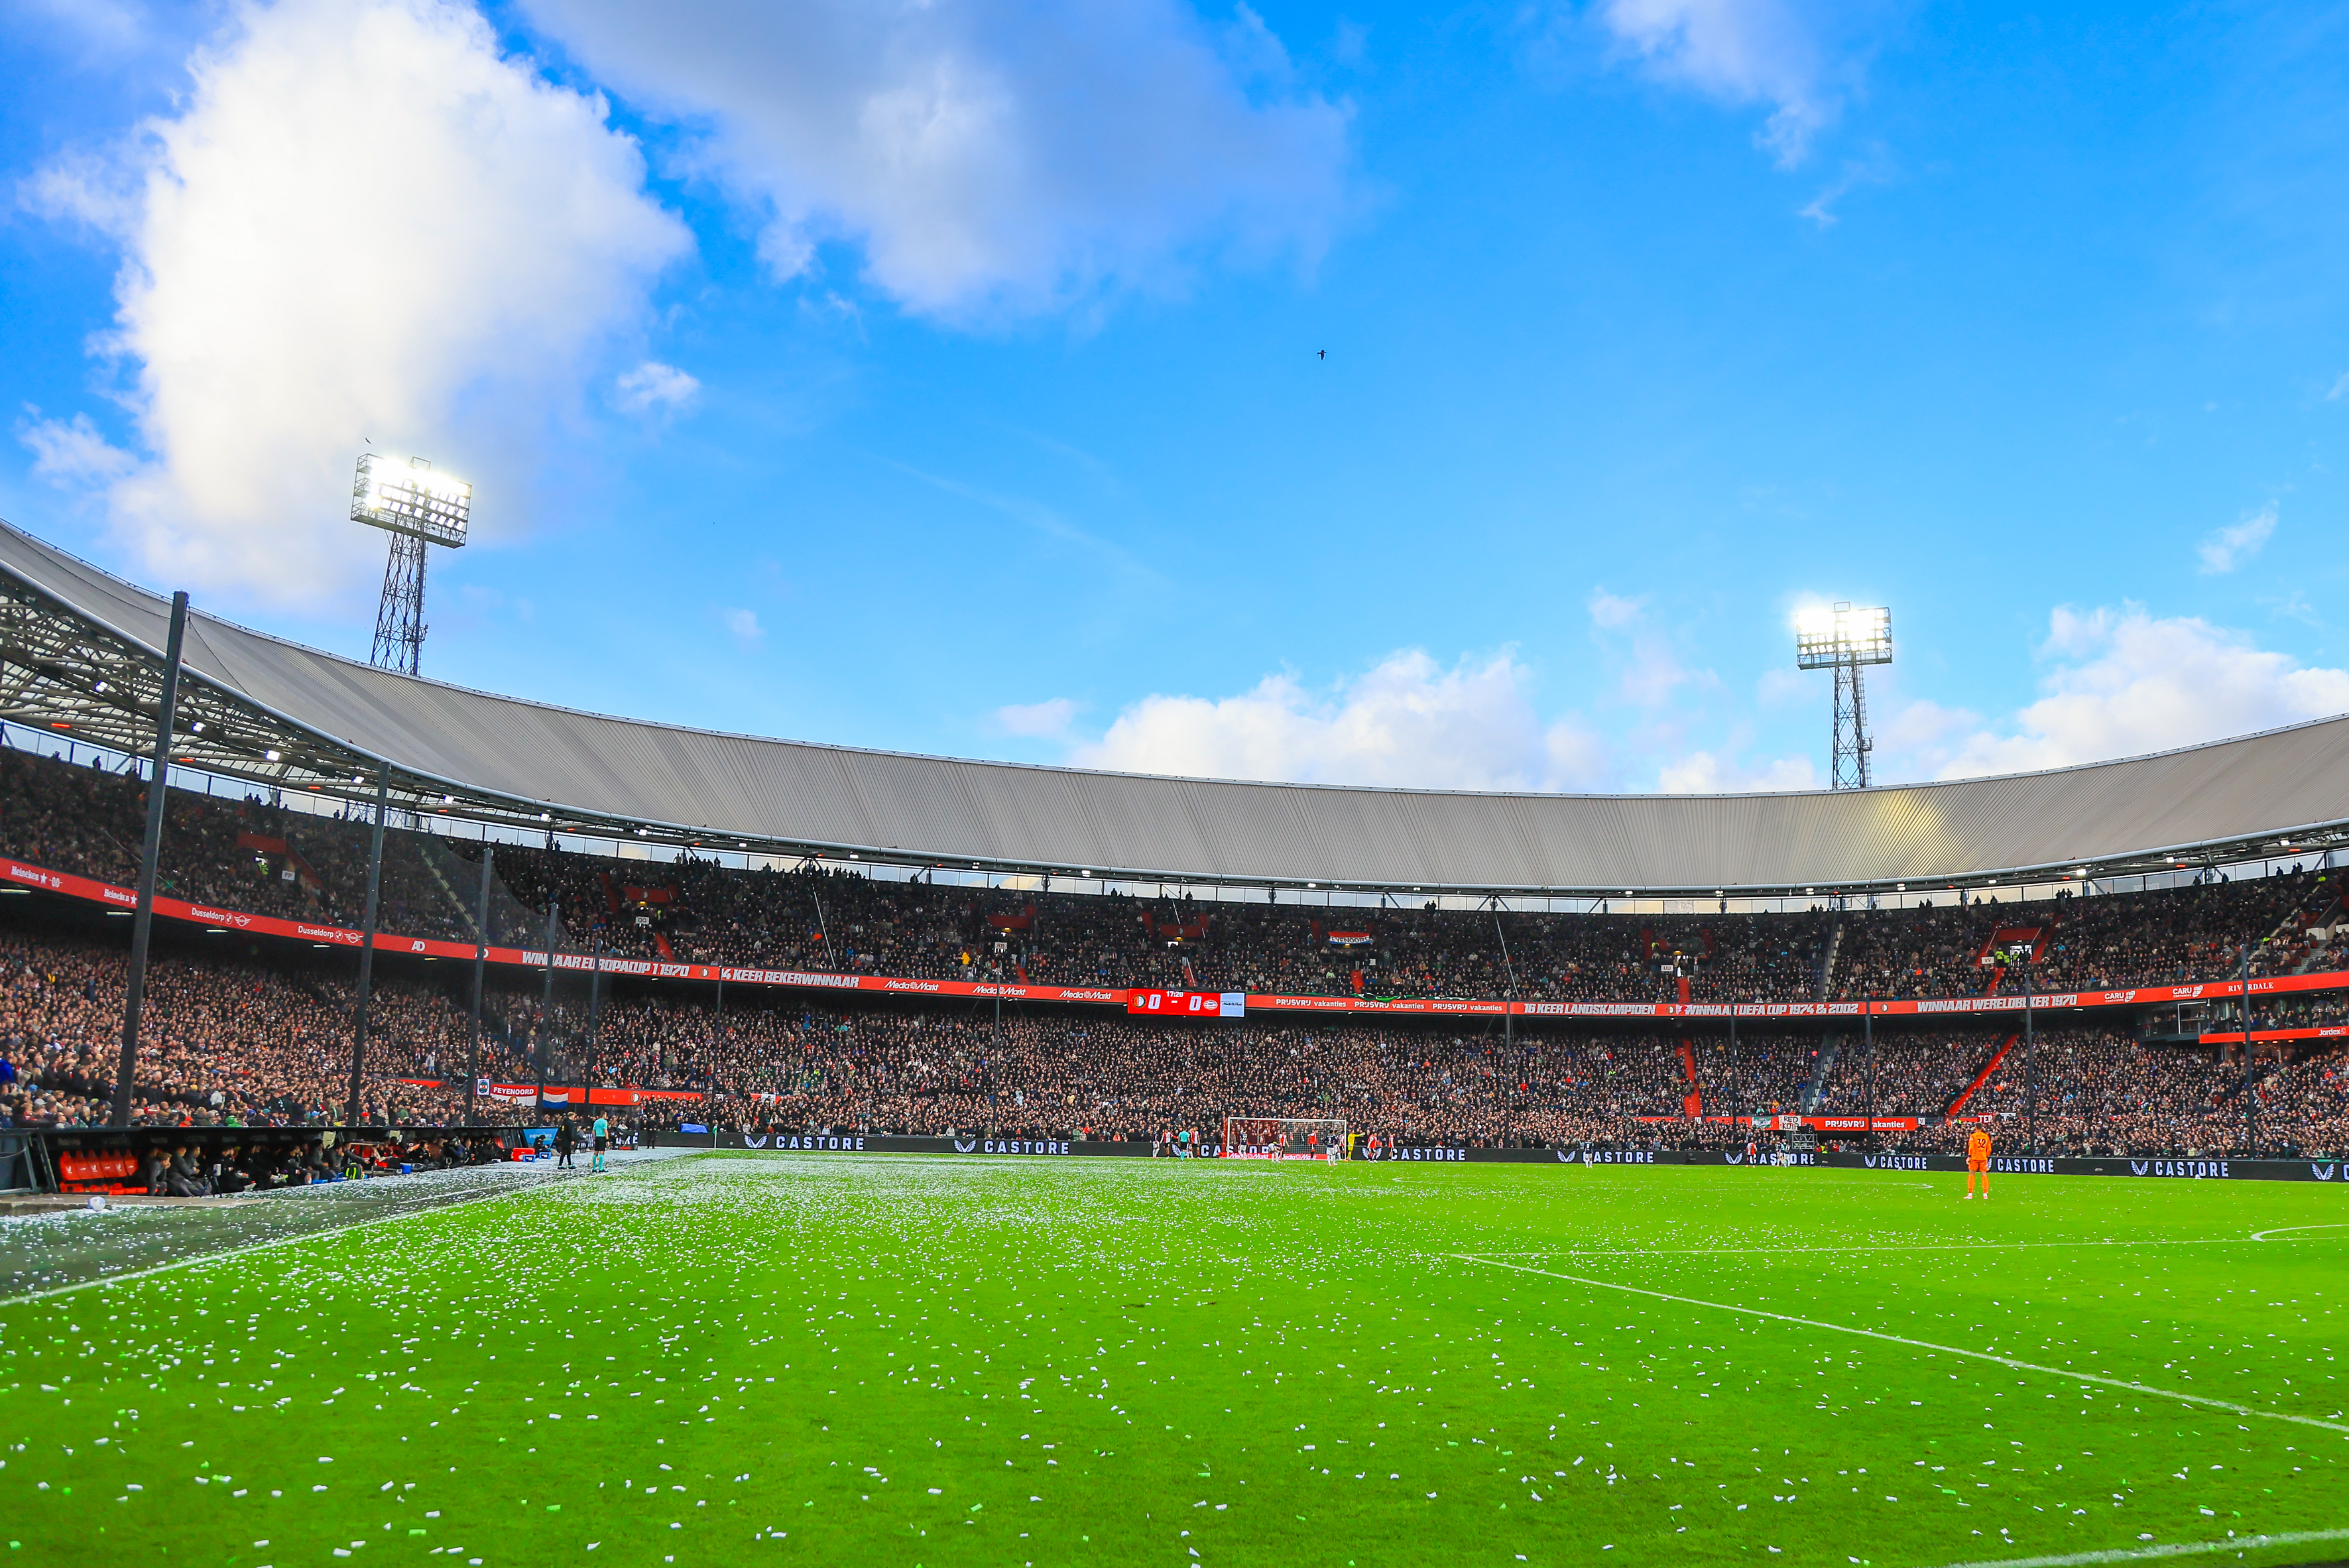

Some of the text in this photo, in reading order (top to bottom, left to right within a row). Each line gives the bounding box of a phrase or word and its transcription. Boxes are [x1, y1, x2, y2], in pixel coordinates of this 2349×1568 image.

[11, 865, 39, 881] Heineken
[192, 907, 225, 922] Dusseldorp
[298, 926, 334, 939] Dusseldorp
[411, 940, 426, 951] AD
[659, 964, 690, 977] 1970
[733, 969, 764, 982] KEER
[764, 971, 860, 988] BEKERWINNAAR
[2228, 982, 2274, 993] RIVRDALE
[1148, 994, 1162, 1010] 0
[1189, 996, 1202, 1011] 0
[1524, 1003, 1656, 1014] 16 KEER LANDSKAMPIOEN
[1738, 1004, 1766, 1015] UEFA
[1766, 1004, 1787, 1015] CUP
[1789, 1004, 1815, 1014] 1974
[1828, 1003, 1859, 1014] 2002
[1917, 1000, 1971, 1012] WINNAAR
[2051, 994, 2078, 1006] 1970
[776, 1135, 865, 1150] CASTORE
[984, 1140, 1070, 1155] CASTORE
[1977, 1139, 1986, 1148] 32
[1201, 1145, 1270, 1158] CASOR
[1392, 1148, 1465, 1161] CASTORE
[1749, 1153, 1815, 1165] CASORE
[1880, 1156, 1927, 1170] CASTORE
[1997, 1158, 2055, 1173] CASTORE
[2155, 1161, 2230, 1177] CASTORE
